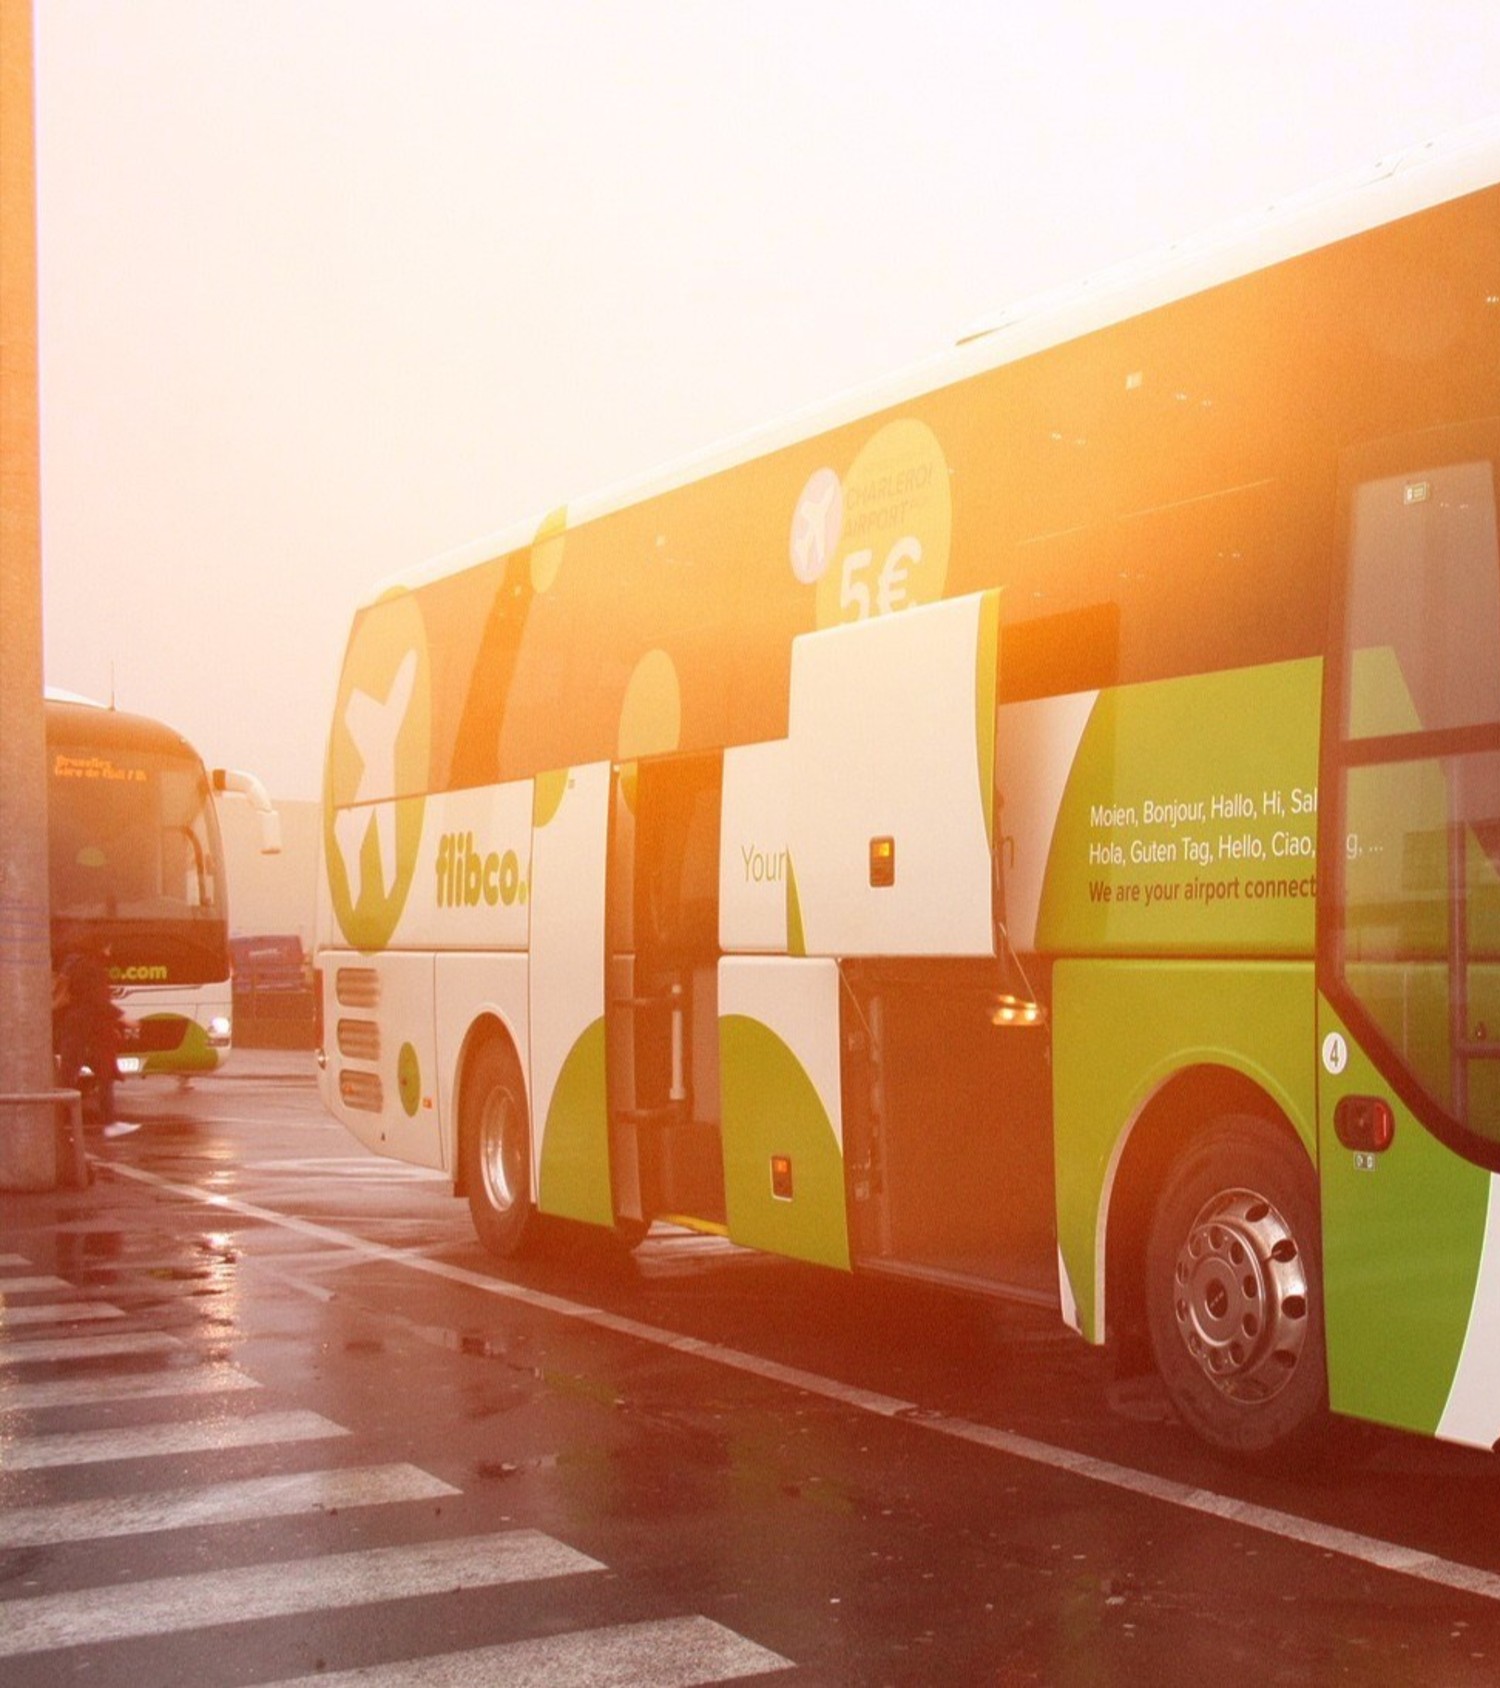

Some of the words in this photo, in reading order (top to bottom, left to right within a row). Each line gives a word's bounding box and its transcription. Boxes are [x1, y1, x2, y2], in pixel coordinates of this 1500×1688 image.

[1090, 805, 1140, 828] Moien,
[1143, 799, 1207, 827] Bonjour,
[1210, 794, 1258, 820] Hallo,
[1262, 791, 1286, 815] Hi,
[1089, 842, 1127, 866] Hola,
[1130, 839, 1178, 864] Guten
[1182, 837, 1214, 865] Tag,
[1218, 833, 1267, 860] Hello,
[1271, 830, 1317, 858] Ciao,
[1088, 881, 1113, 902] We
[1115, 883, 1141, 902] are
[1144, 882, 1179, 907] your
[1184, 877, 1240, 906] airport
[1244, 873, 1317, 899] connect
[1329, 1039, 1340, 1069] 4
